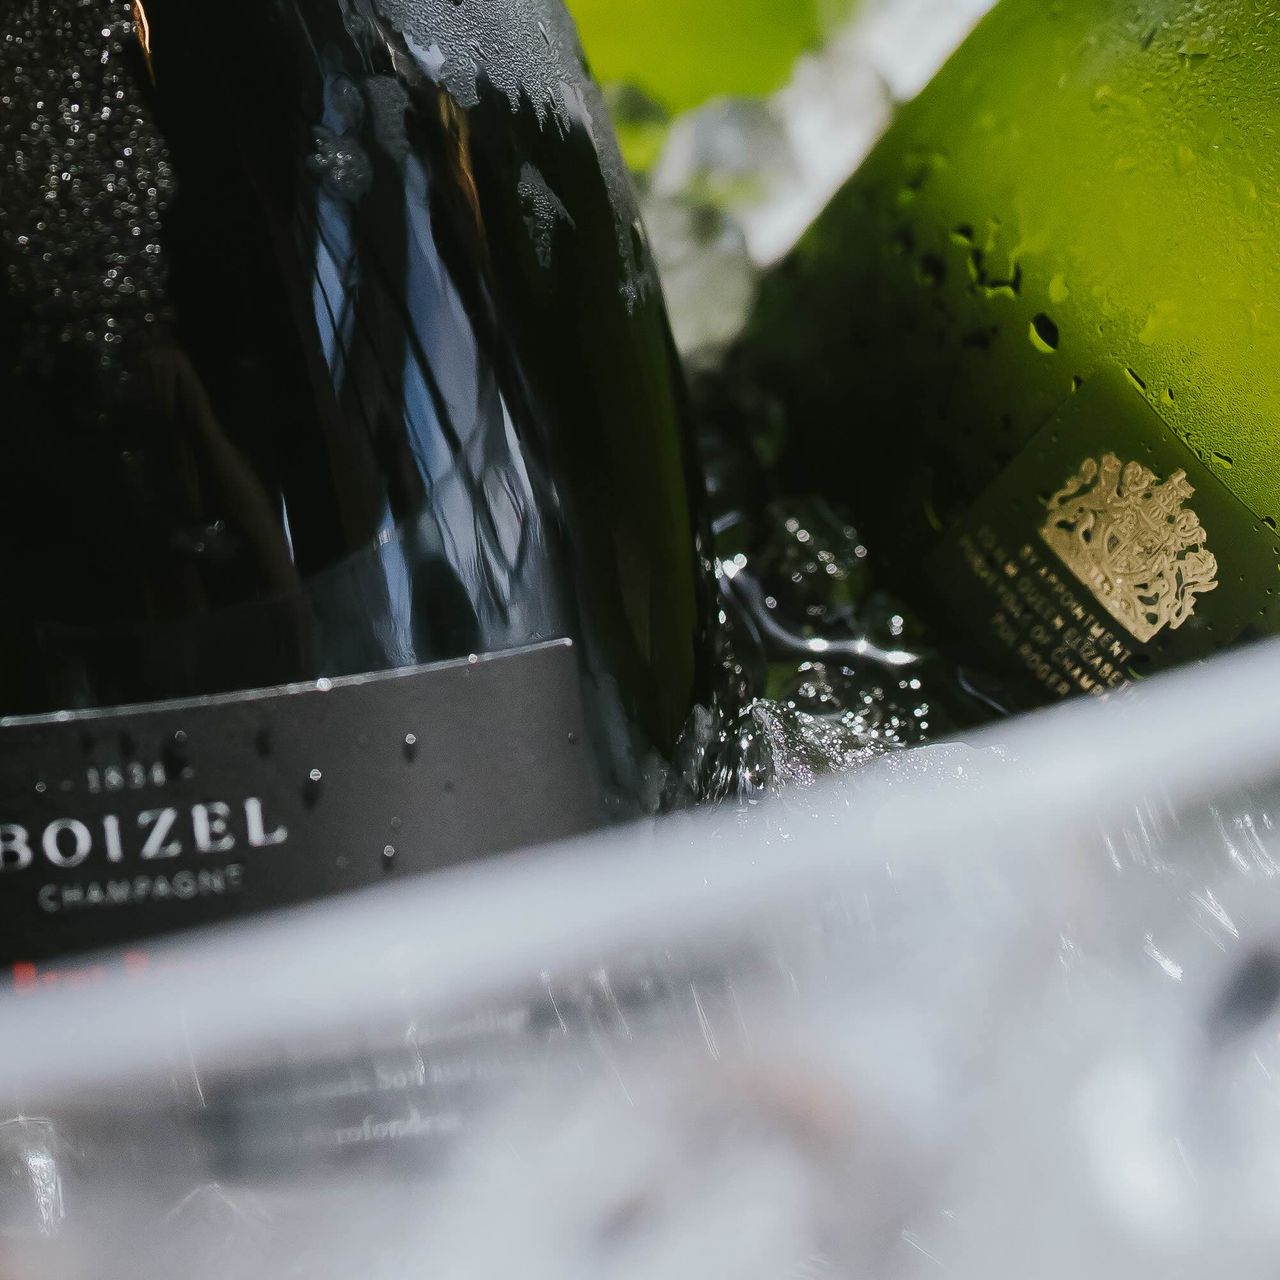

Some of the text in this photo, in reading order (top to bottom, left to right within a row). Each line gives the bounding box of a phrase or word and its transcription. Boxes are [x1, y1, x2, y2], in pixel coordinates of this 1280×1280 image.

[1016, 575, 1067, 630] QUEEN
[1035, 564, 1132, 664] APPOINTMENT
[1017, 641, 1070, 696] ROGER
[38, 863, 244, 912] CHAMPAGNE
